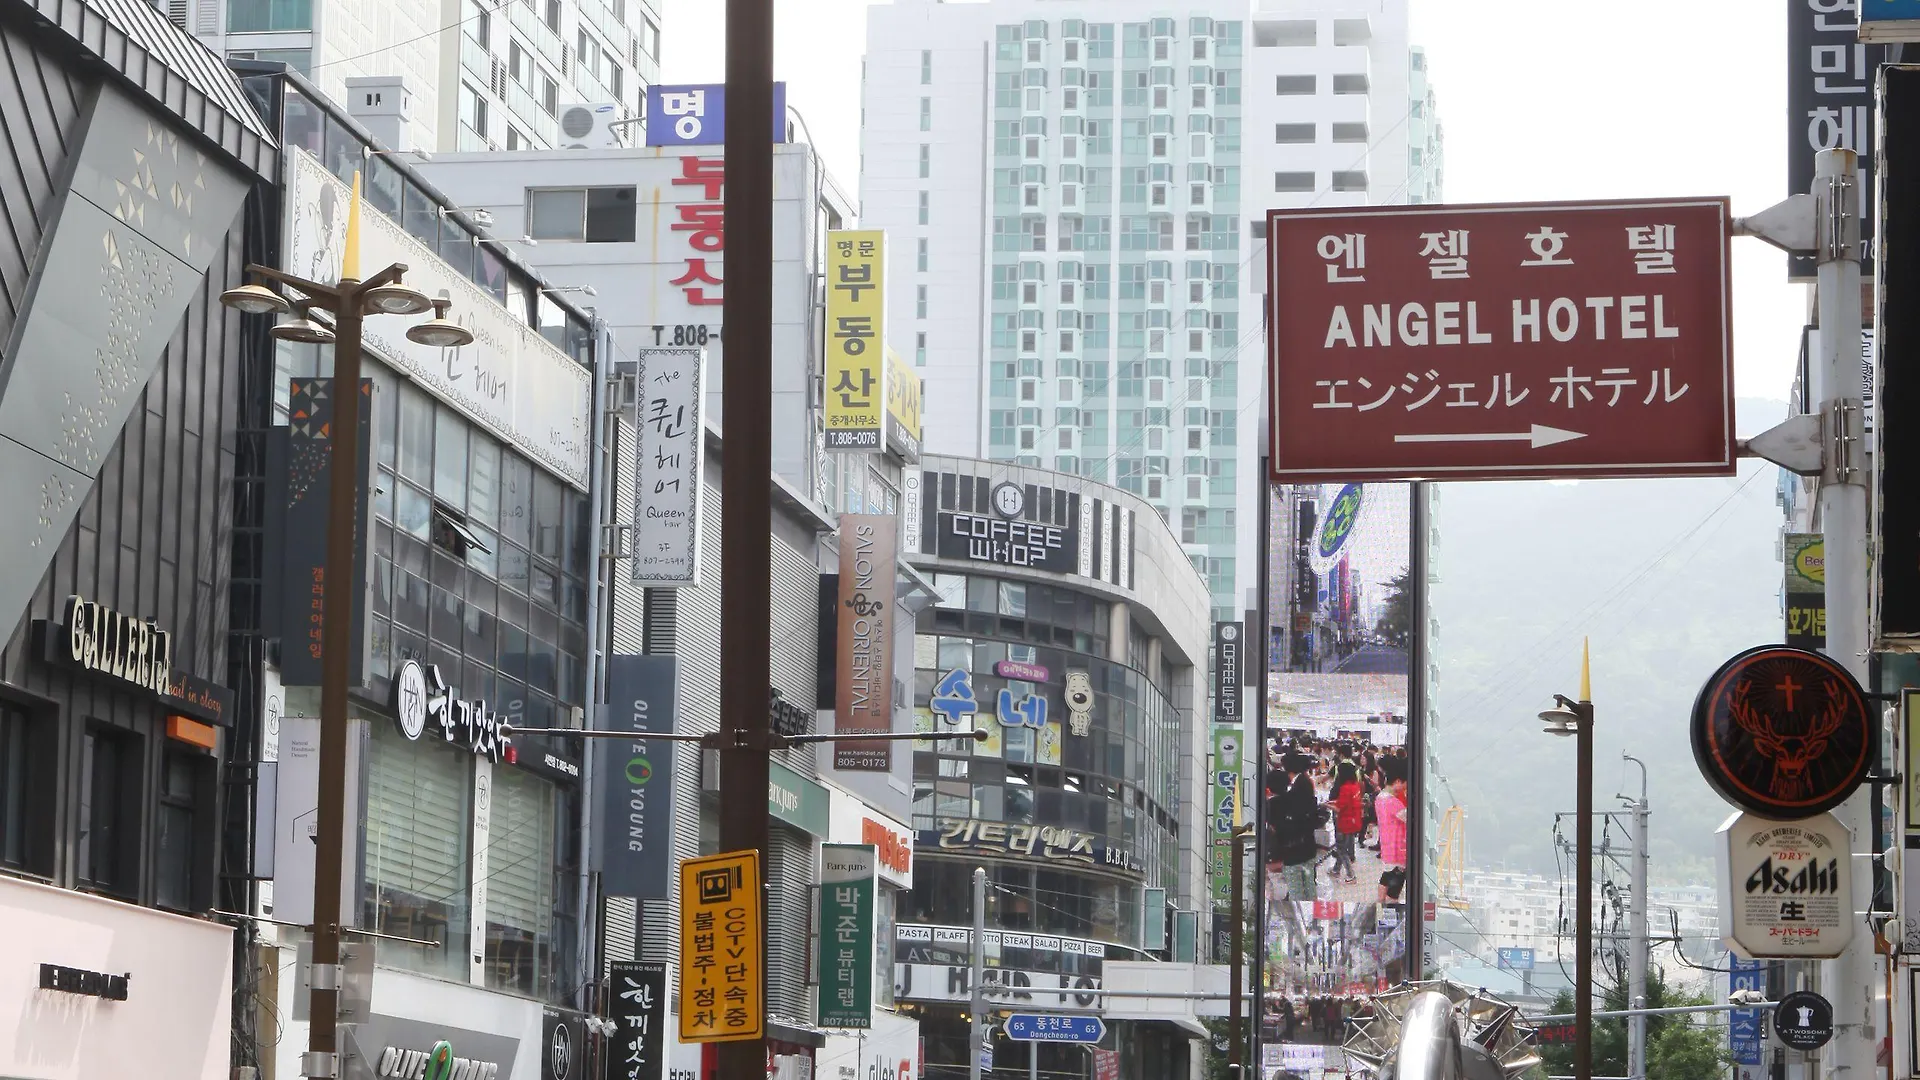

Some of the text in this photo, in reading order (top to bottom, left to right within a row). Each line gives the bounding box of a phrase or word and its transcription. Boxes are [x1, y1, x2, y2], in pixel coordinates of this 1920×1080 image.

[661, 90, 705, 139] 명
[837, 240, 876, 257] 명문
[1323, 294, 1680, 348] ANGEL HOTEL
[832, 264, 876, 407] 부동산
[654, 370, 681, 387] The
[1312, 366, 1690, 412] エンジェル ホテル
[829, 414, 878, 426] 중개사무소
[830, 431, 876, 445] T.808-0076
[646, 506, 686, 519] Queen
[953, 515, 1062, 549] COFFEE
[851, 525, 873, 716] SALON ORIENTAL
[68, 594, 171, 695] GALLERIA
[837, 757, 886, 767] 805-0173
[628, 700, 648, 851] OLIE YOUNG
[1106, 847, 1129, 870] B.B.Q
[1745, 856, 1839, 894] Asahi
[835, 887, 861, 944] 박준
[1780, 901, 1806, 921] 生
[899, 929, 929, 938] PASTA
[936, 931, 965, 940] PILAFF
[1004, 936, 1030, 946] STEAK
[1034, 939, 1058, 949] SALAD
[1063, 942, 1082, 952] PIZZA
[1088, 945, 1102, 954] BEER
[1769, 927, 1820, 937] スーパードライ
[823, 1017, 868, 1027] 807 1170
[1013, 1022, 1096, 1033] 65 63
[1036, 1017, 1073, 1031] 동천로
[1030, 1031, 1079, 1039] Dongcheon-ro
[380, 1045, 431, 1080] OLIVE
